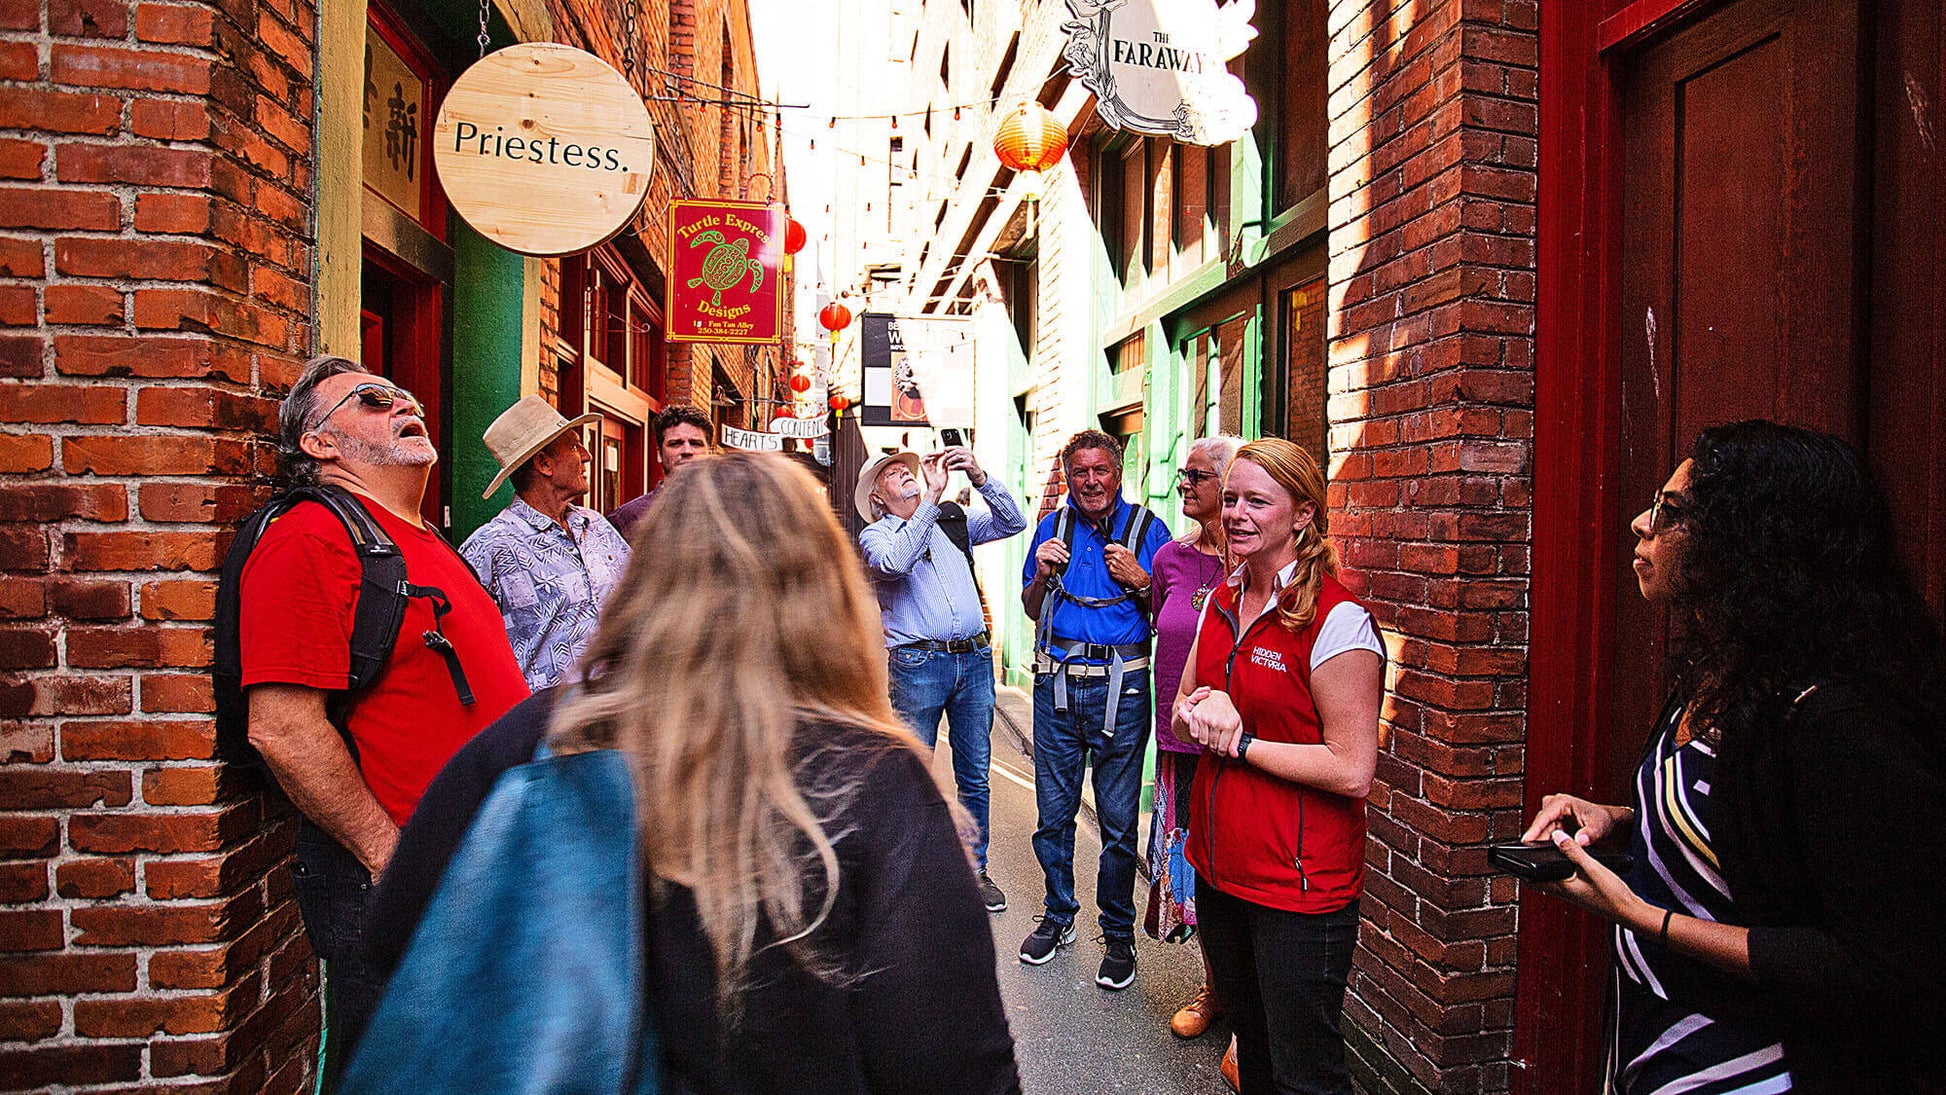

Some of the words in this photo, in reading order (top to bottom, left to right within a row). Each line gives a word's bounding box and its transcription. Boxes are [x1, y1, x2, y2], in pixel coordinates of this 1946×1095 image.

[1153, 31, 1169, 44] TH
[1113, 39, 1206, 74] FARAWAY
[454, 121, 629, 173] Priestess.
[677, 214, 721, 239] Turtle
[697, 299, 751, 320] Designs
[697, 327, 748, 335] 250-384-2227
[708, 320, 722, 328] Fan
[737, 321, 754, 330] Alley
[780, 419, 825, 436] CONTENT
[724, 427, 778, 451] HEARTS
[1252, 645, 1282, 661] HIDDEN
[1250, 654, 1287, 673] VICTORIA
